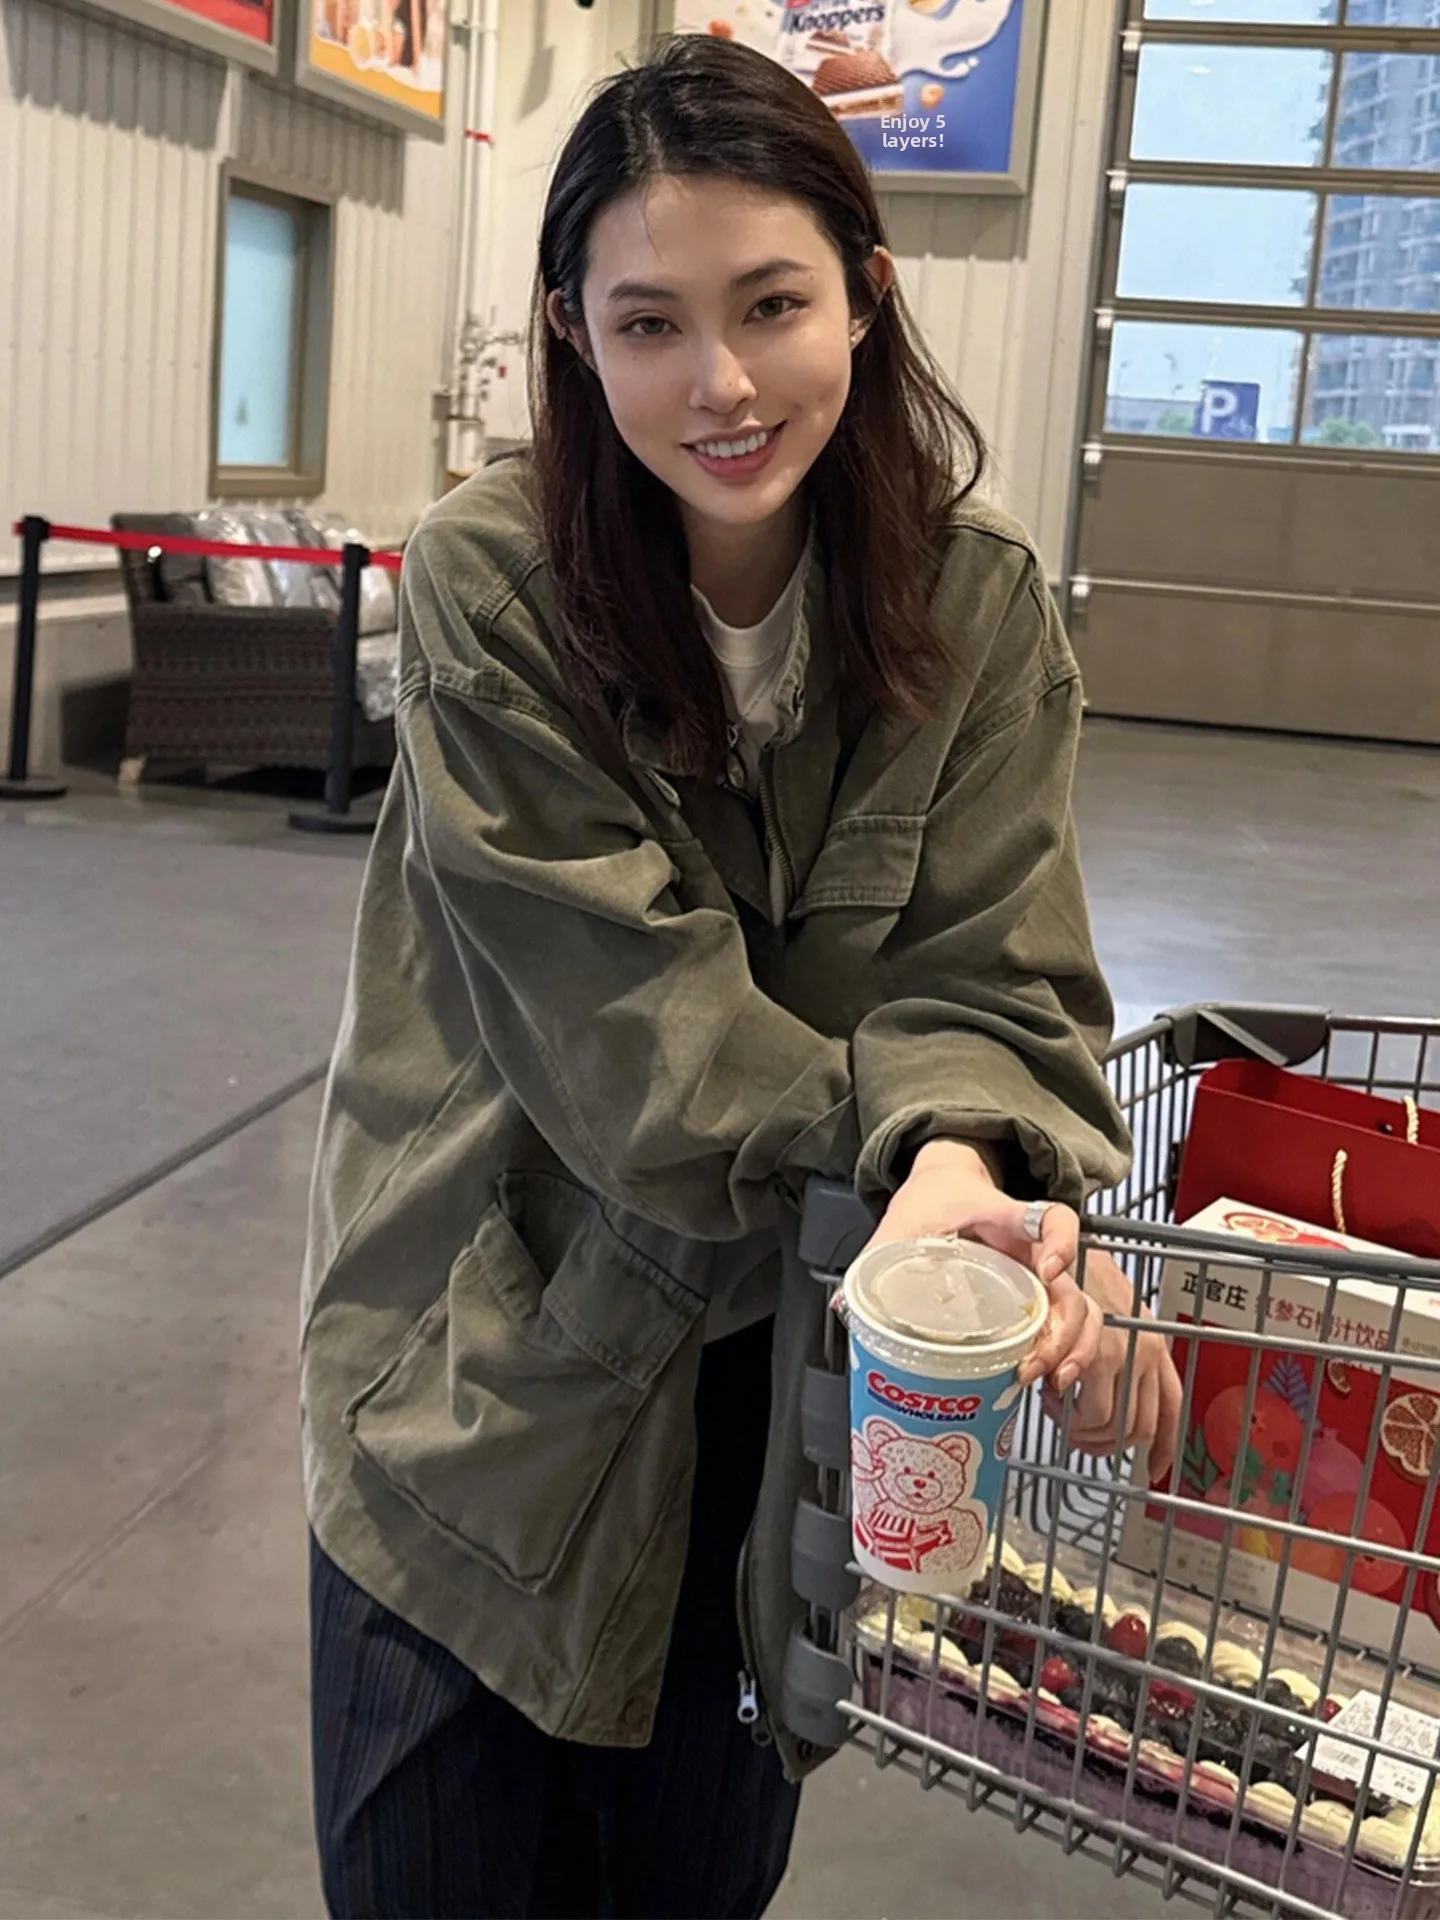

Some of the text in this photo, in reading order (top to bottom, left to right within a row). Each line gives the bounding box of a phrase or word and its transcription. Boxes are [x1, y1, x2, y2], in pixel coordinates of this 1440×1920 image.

[789, 4, 885, 35] Knoppers
[881, 113, 946, 133] Enjoy 5
[882, 132, 945, 152] layers!
[1200, 387, 1238, 434] P
[1181, 1271, 1249, 1311] 正官庄
[867, 1370, 982, 1414] COSTCO
[896, 1405, 977, 1422] WHOLESALE
